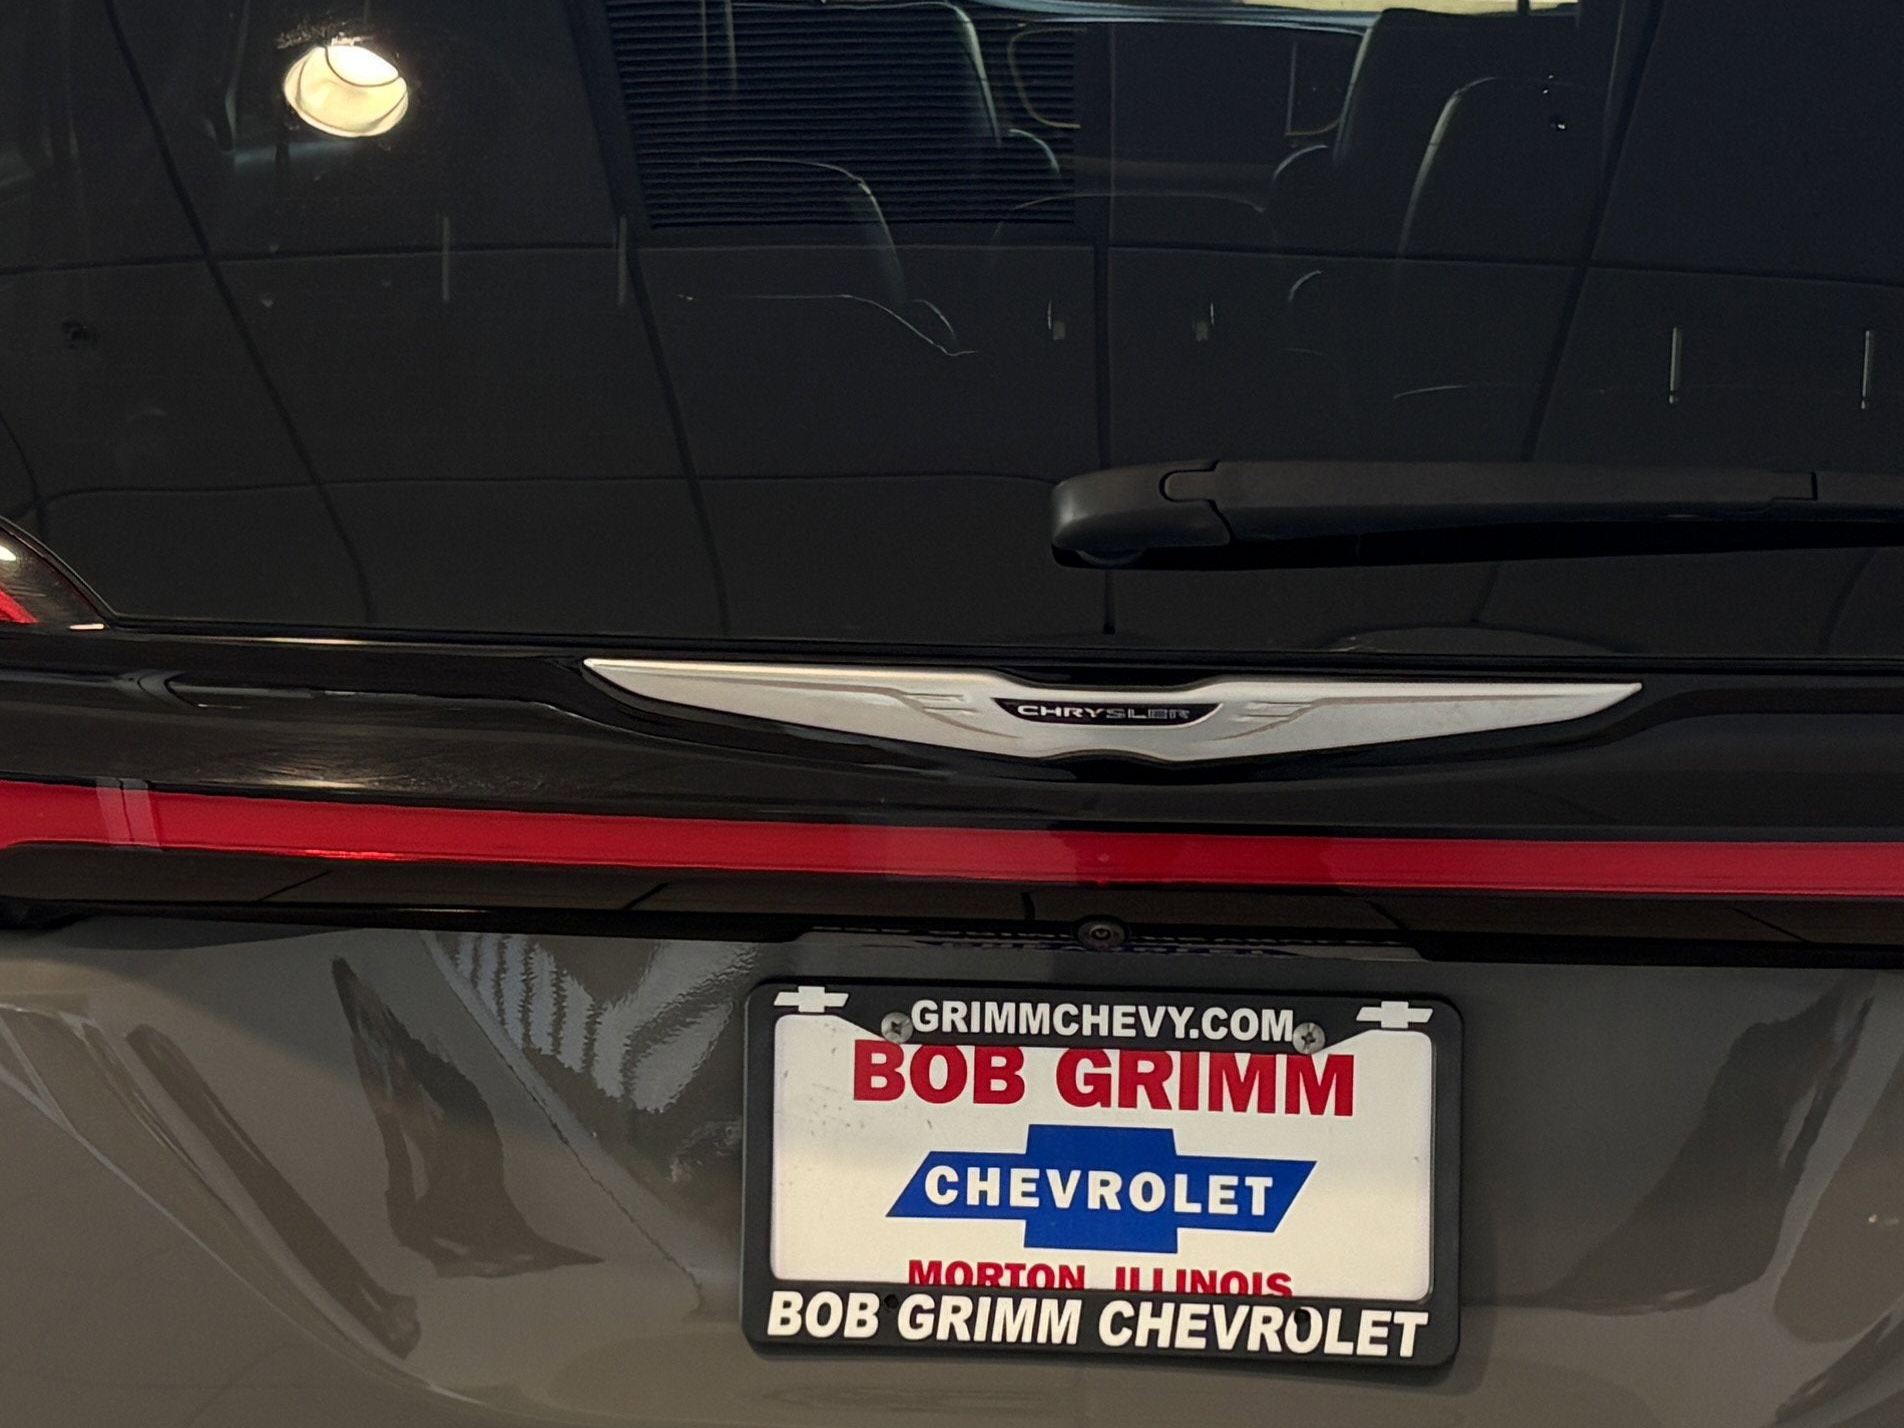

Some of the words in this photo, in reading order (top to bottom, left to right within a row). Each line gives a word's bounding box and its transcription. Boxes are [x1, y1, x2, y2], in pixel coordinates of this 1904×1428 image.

[1017, 705, 1190, 720] CHRYSLER
[910, 999, 1294, 1043] GRIMMCHEVY.COM
[853, 1039, 1026, 1105] BOB
[1055, 1047, 1355, 1117] GRIMM
[924, 1164, 1275, 1216] CHEVROLET
[766, 1290, 879, 1339] BOB
[897, 1295, 1083, 1345] GRIMM
[1098, 1300, 1429, 1358] CHEVROLET
